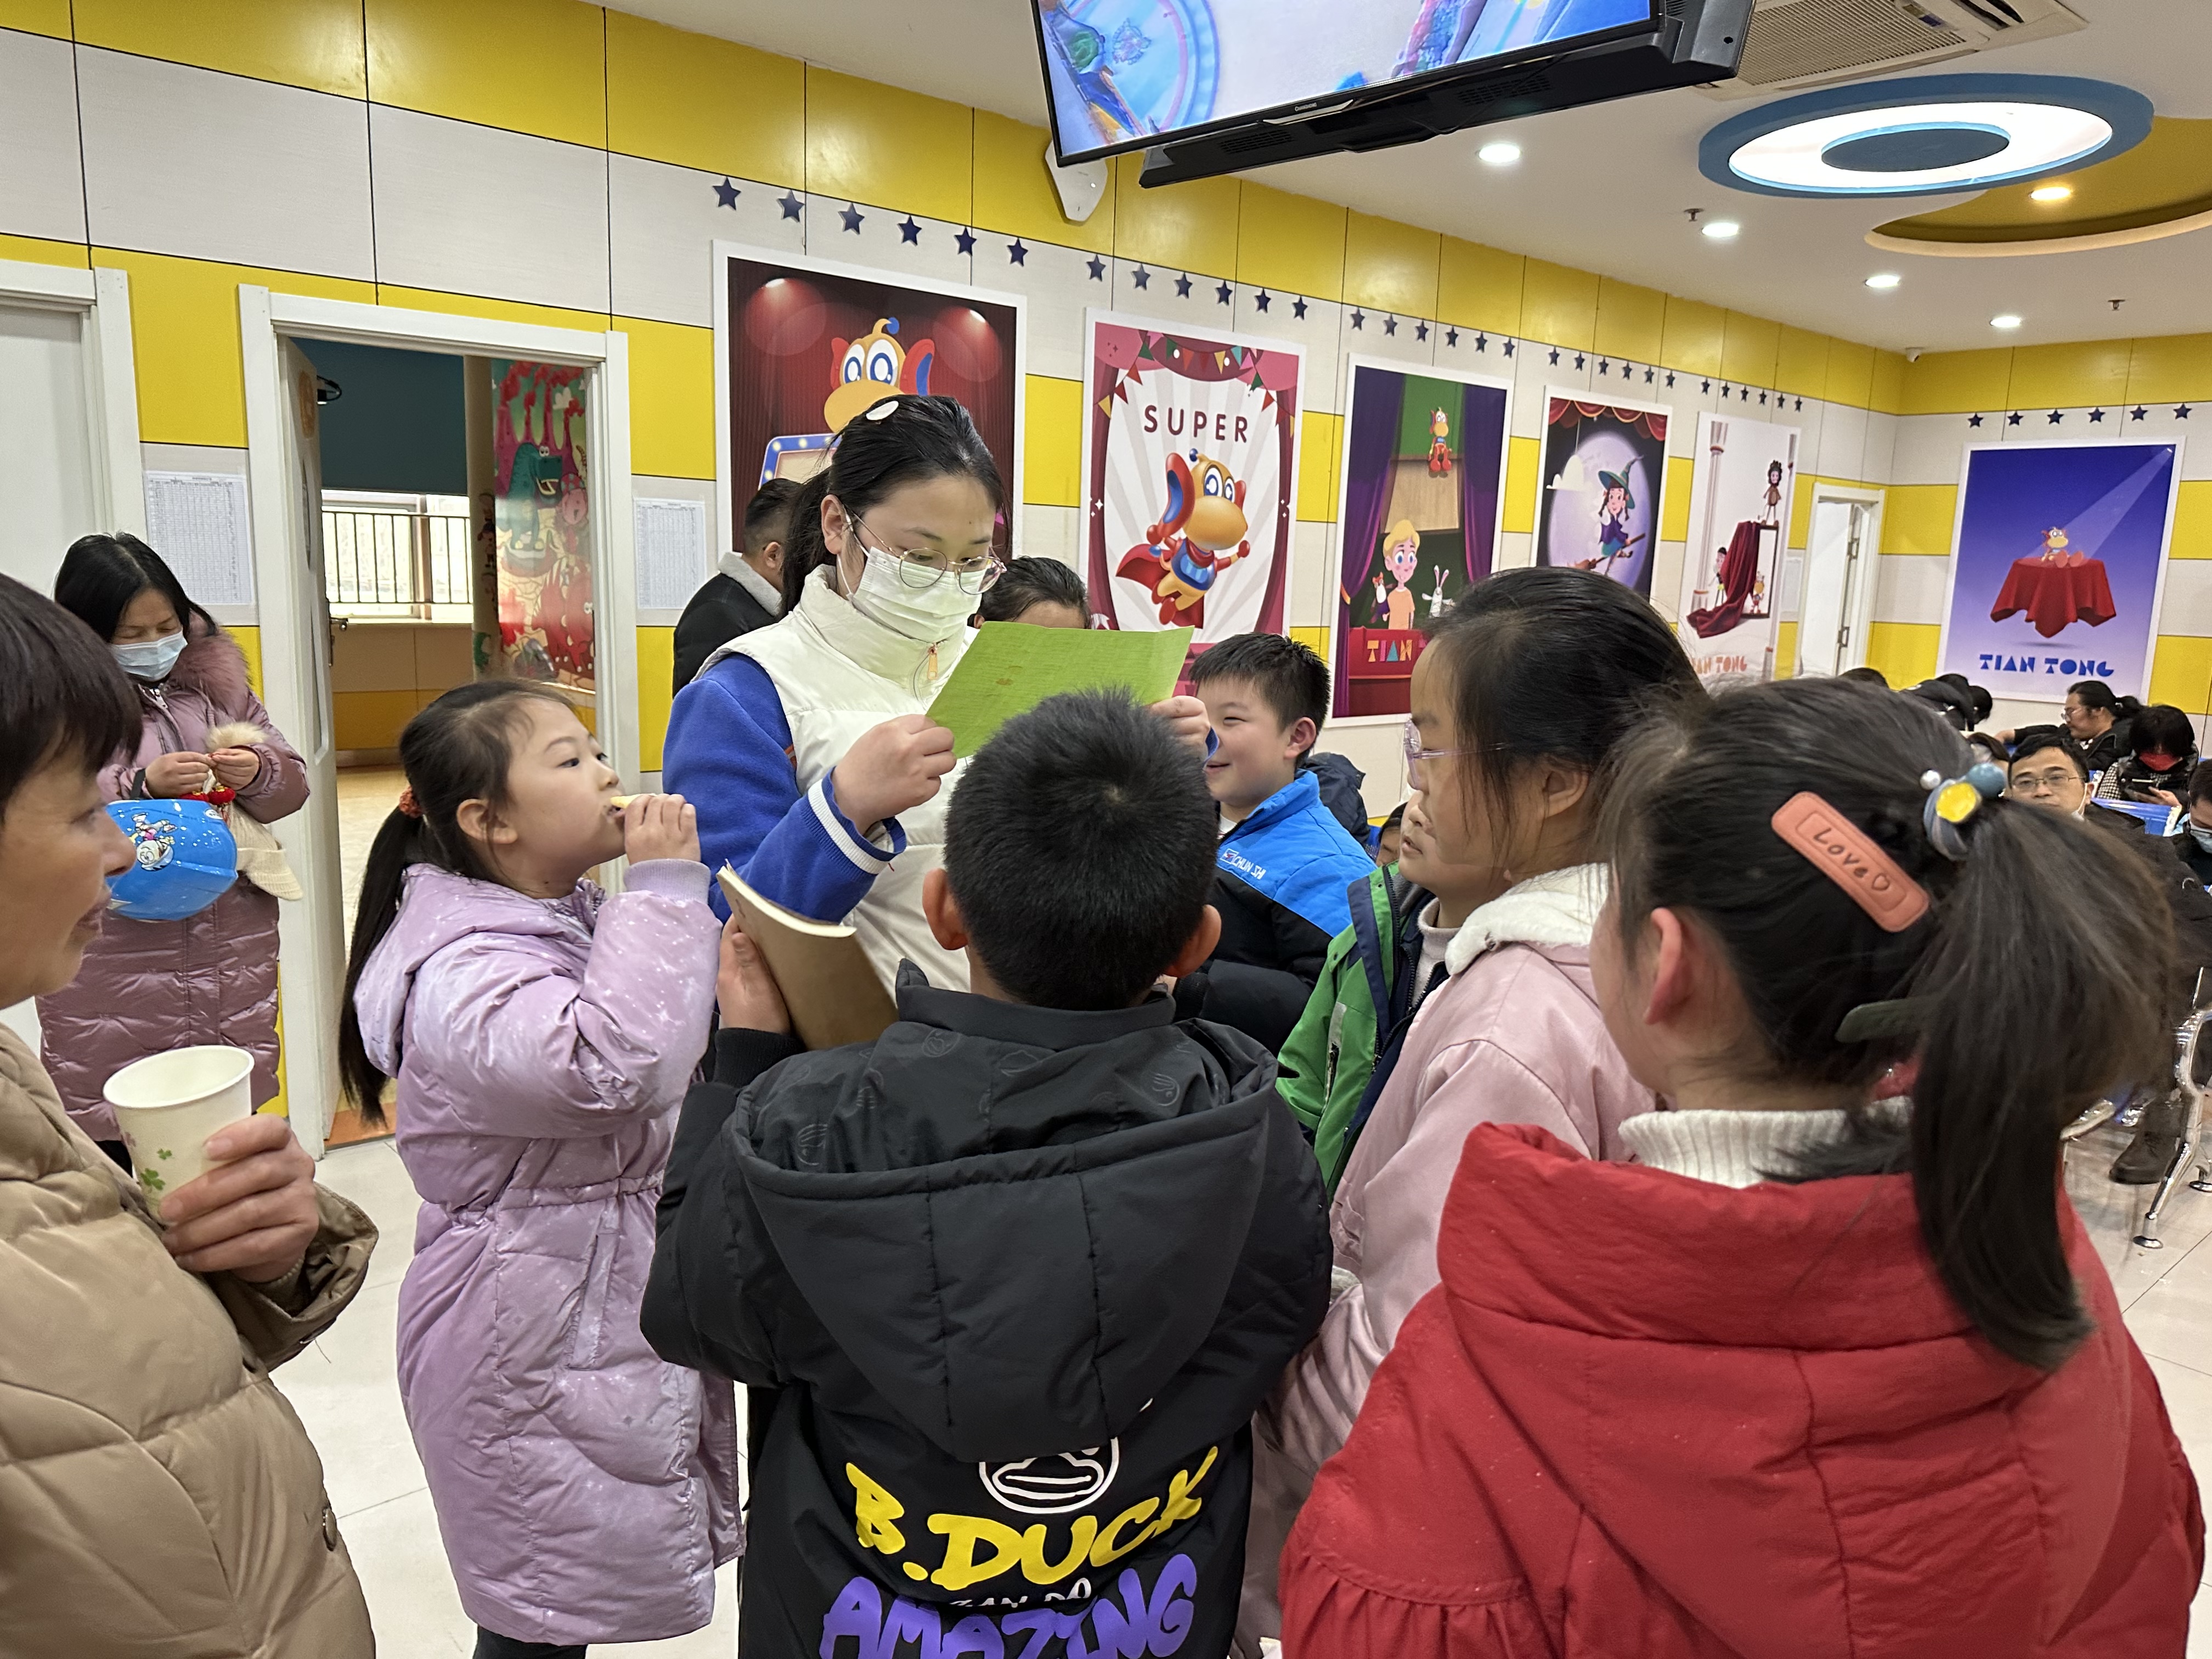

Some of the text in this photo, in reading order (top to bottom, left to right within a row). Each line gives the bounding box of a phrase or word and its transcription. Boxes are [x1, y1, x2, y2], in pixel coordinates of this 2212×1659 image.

[1144, 405, 1248, 443] SUPER
[1367, 640, 1413, 663] TIAN
[1715, 656, 1747, 674] TONG
[1979, 654, 2114, 677] TIAN TONG
